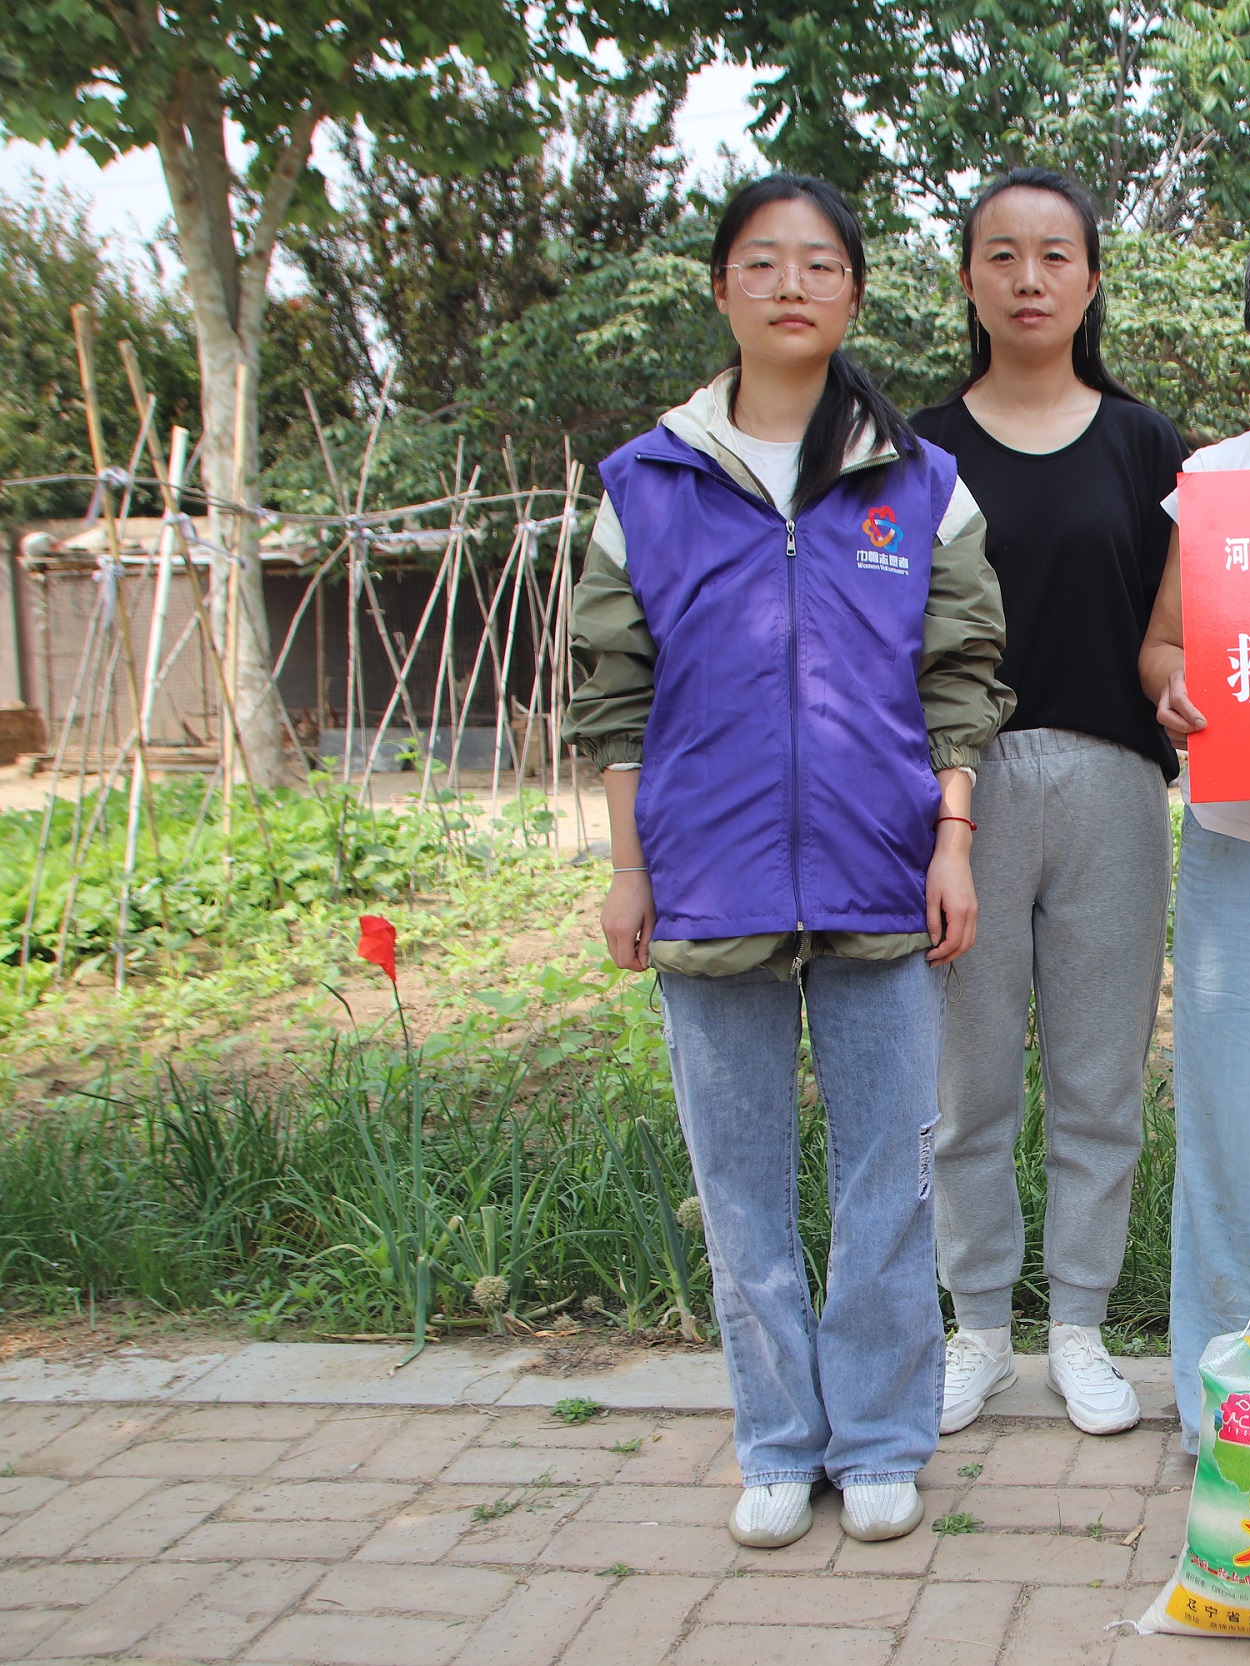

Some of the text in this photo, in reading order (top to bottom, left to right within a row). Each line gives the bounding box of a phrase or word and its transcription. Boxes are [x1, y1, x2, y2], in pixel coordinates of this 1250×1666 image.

[856, 549, 909, 569] 巾帼志愿者
